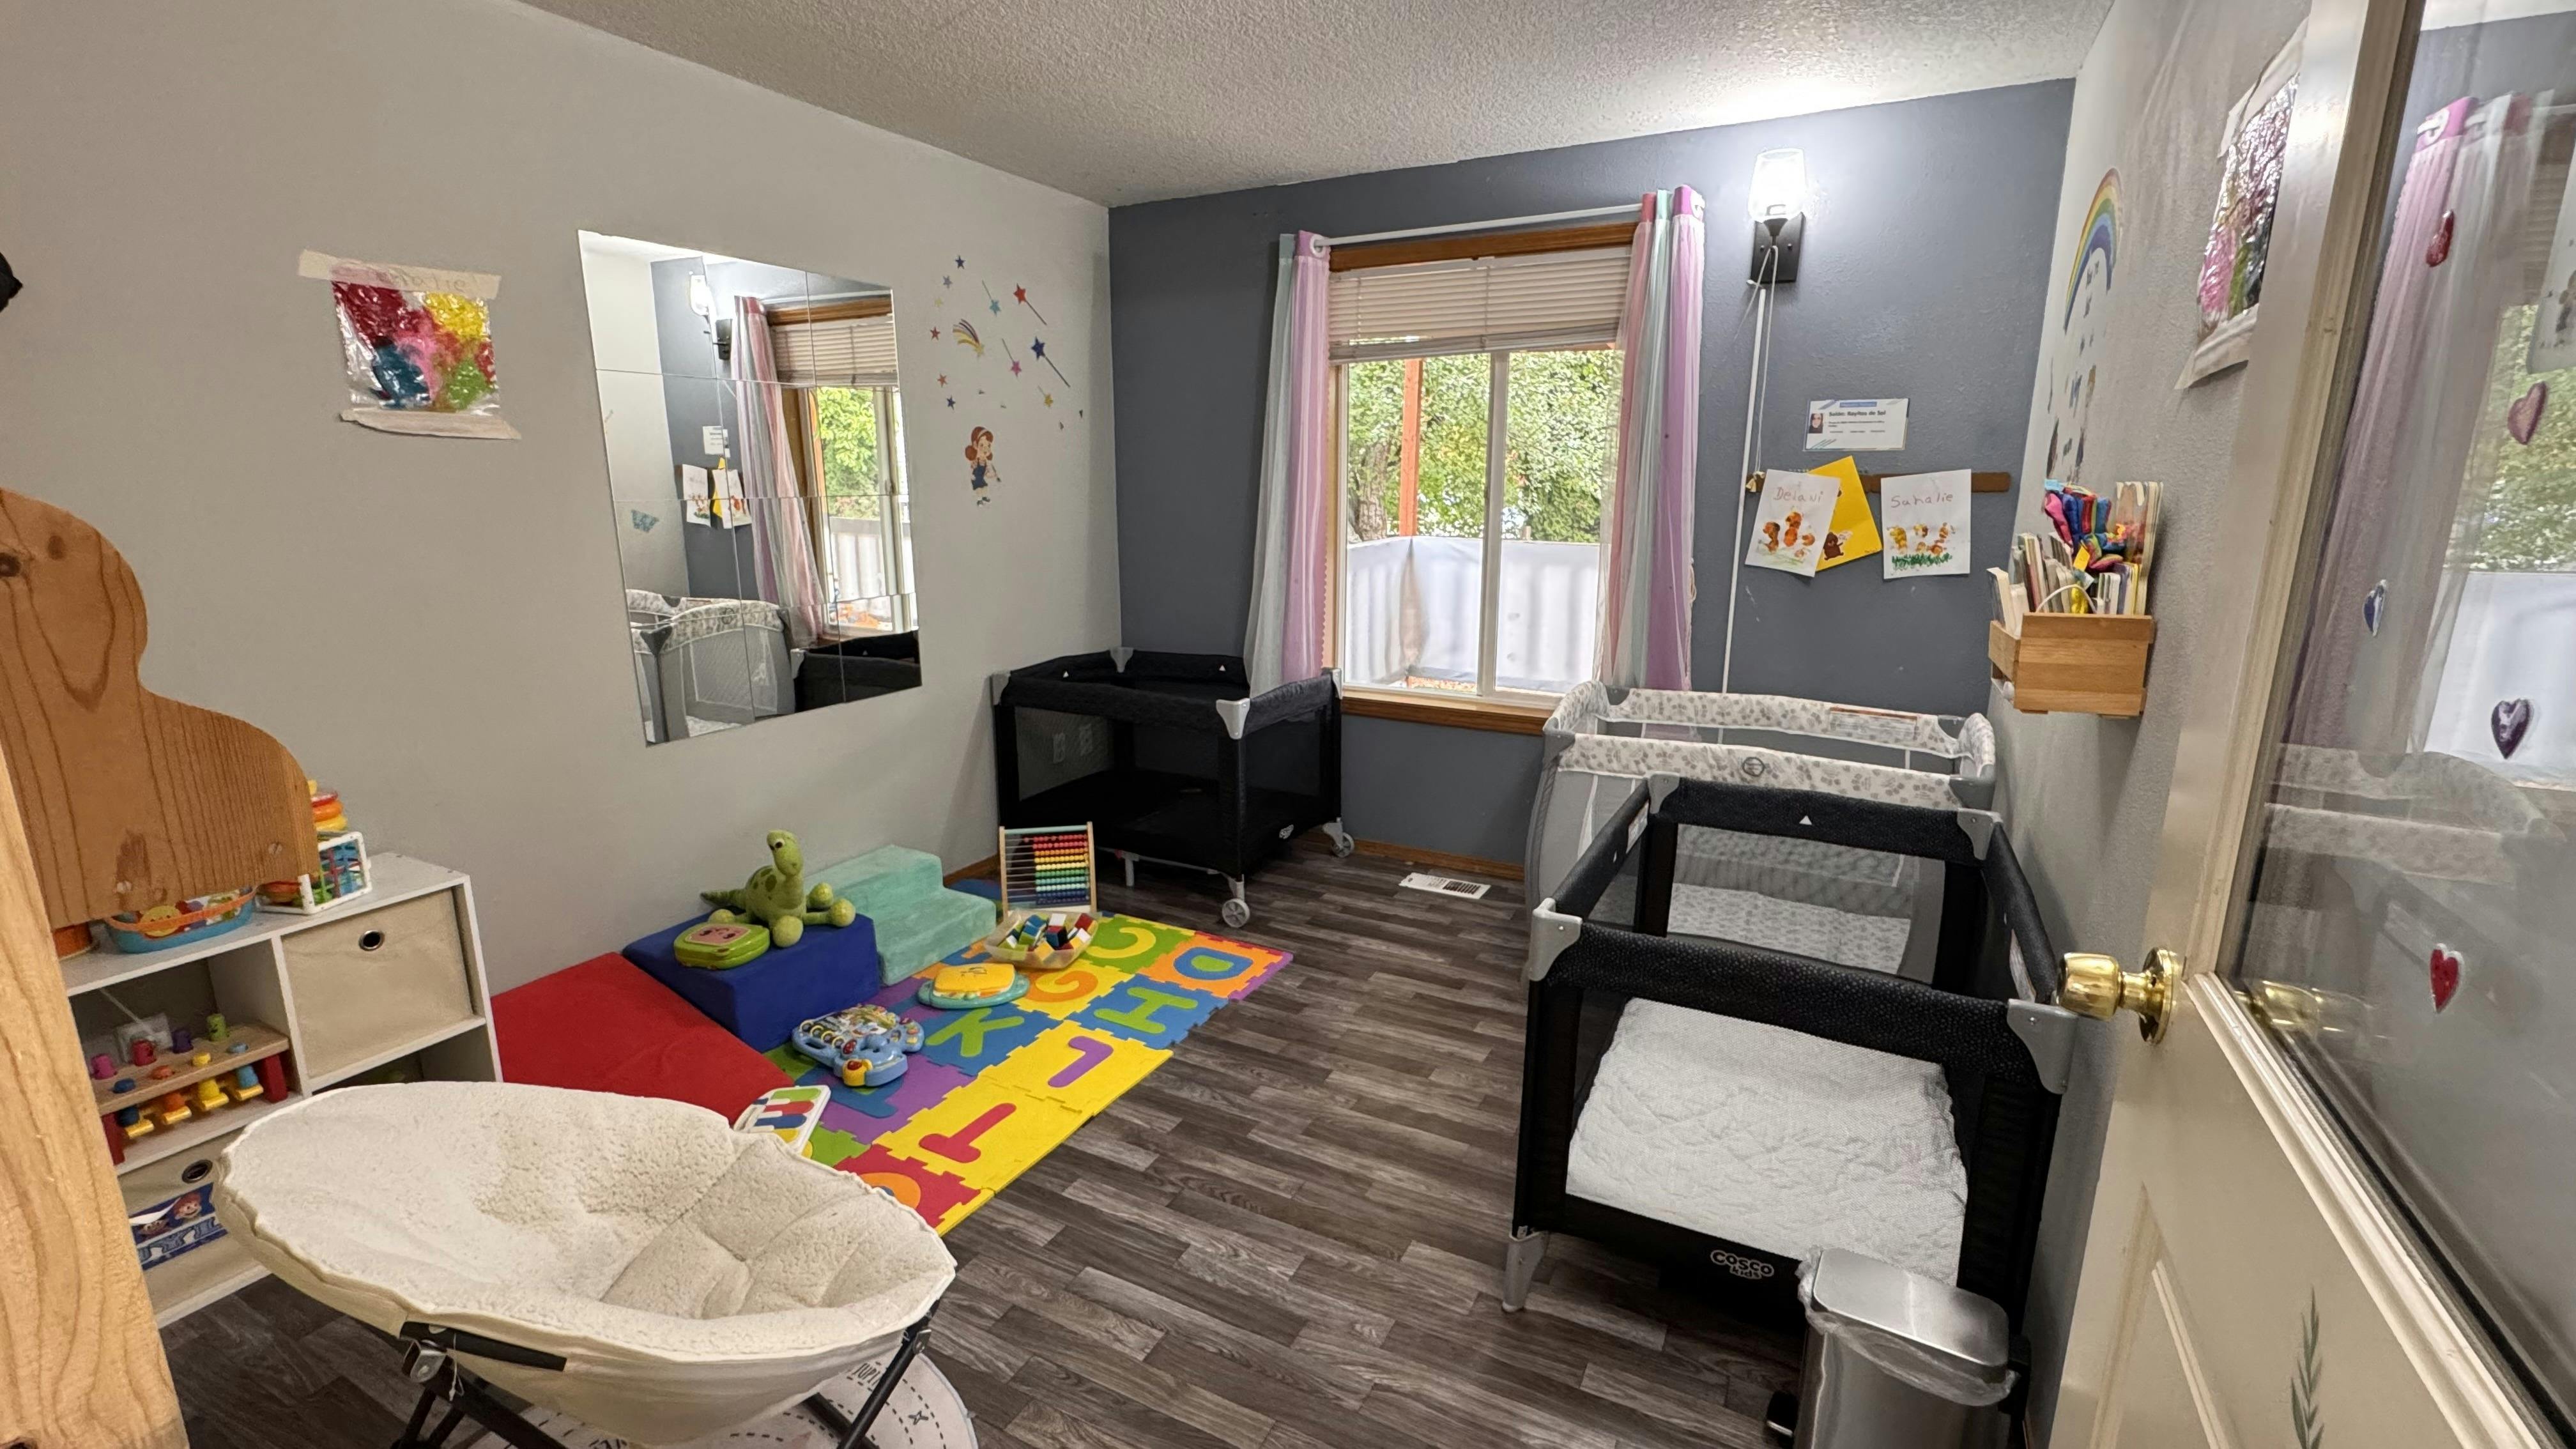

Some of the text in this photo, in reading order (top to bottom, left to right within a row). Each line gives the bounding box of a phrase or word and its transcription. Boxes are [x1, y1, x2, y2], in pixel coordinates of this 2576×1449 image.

[1173, 946, 1254, 981] D
[924, 1008, 1025, 1058] K
[1048, 1035, 1114, 1087] L
[919, 1103, 1016, 1163] T
[852, 1362, 880, 1386] JUPI
